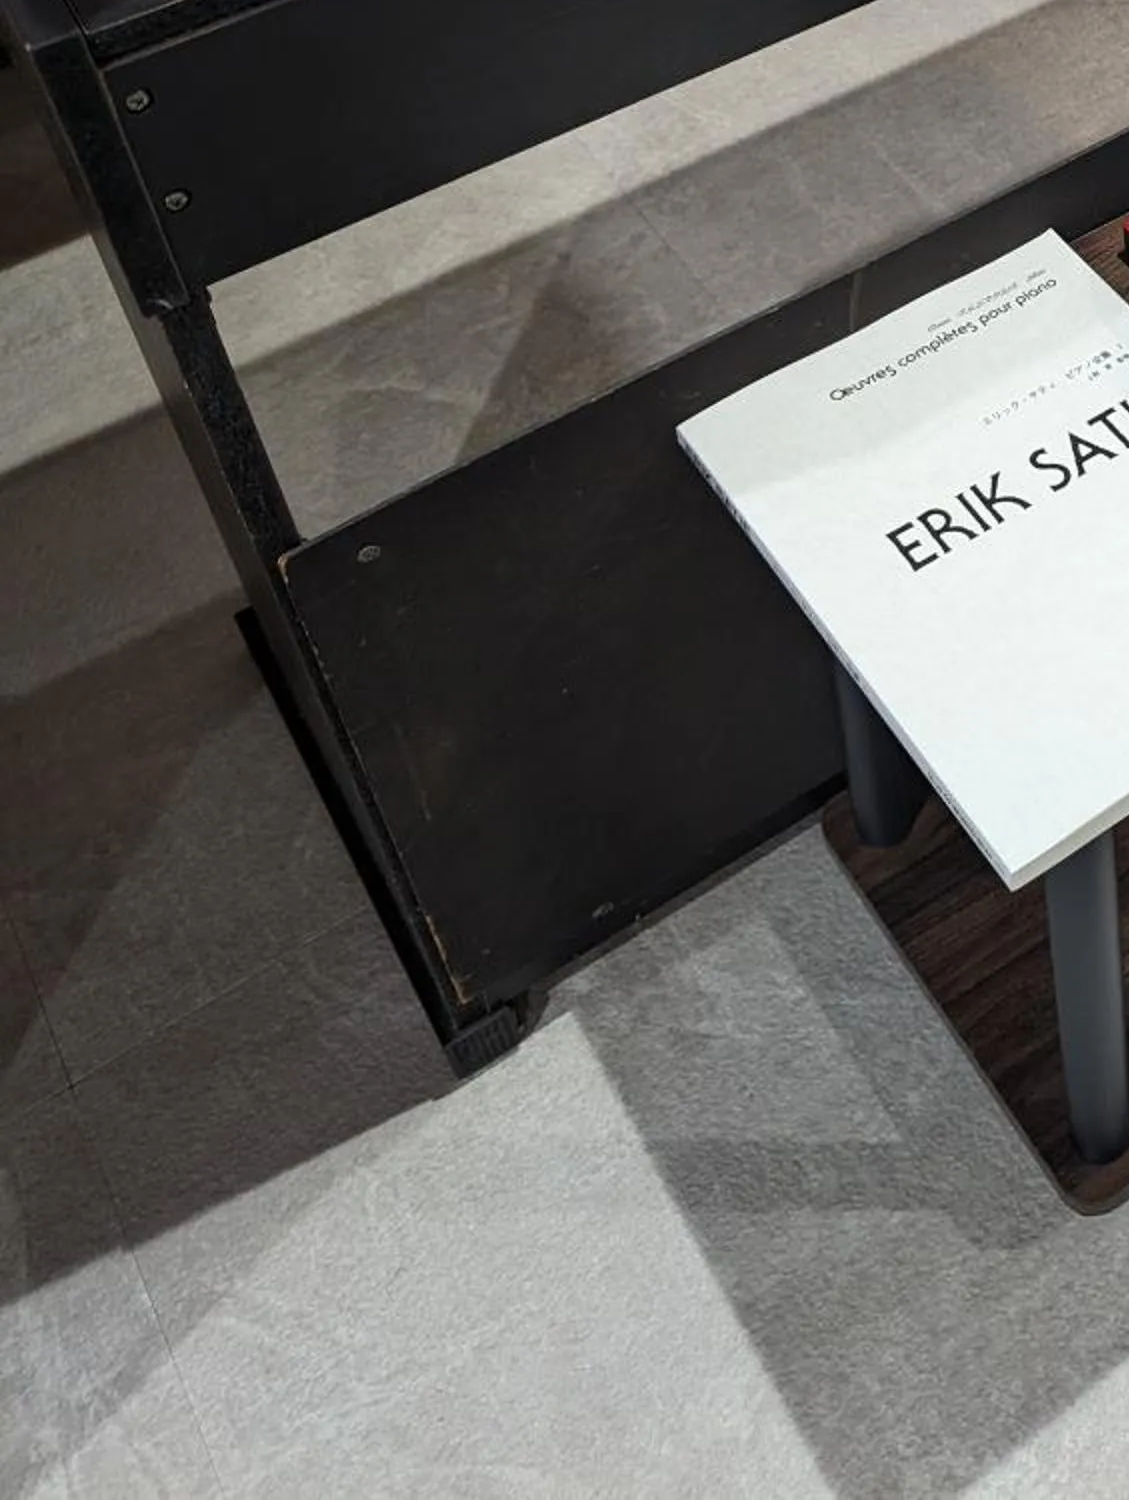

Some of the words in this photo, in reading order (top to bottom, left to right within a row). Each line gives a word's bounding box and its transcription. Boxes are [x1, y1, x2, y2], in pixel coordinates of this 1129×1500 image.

[897, 321, 978, 368] complètes
[979, 302, 1012, 327] pour
[1015, 278, 1057, 307] piano
[886, 472, 1031, 572] ERIK
